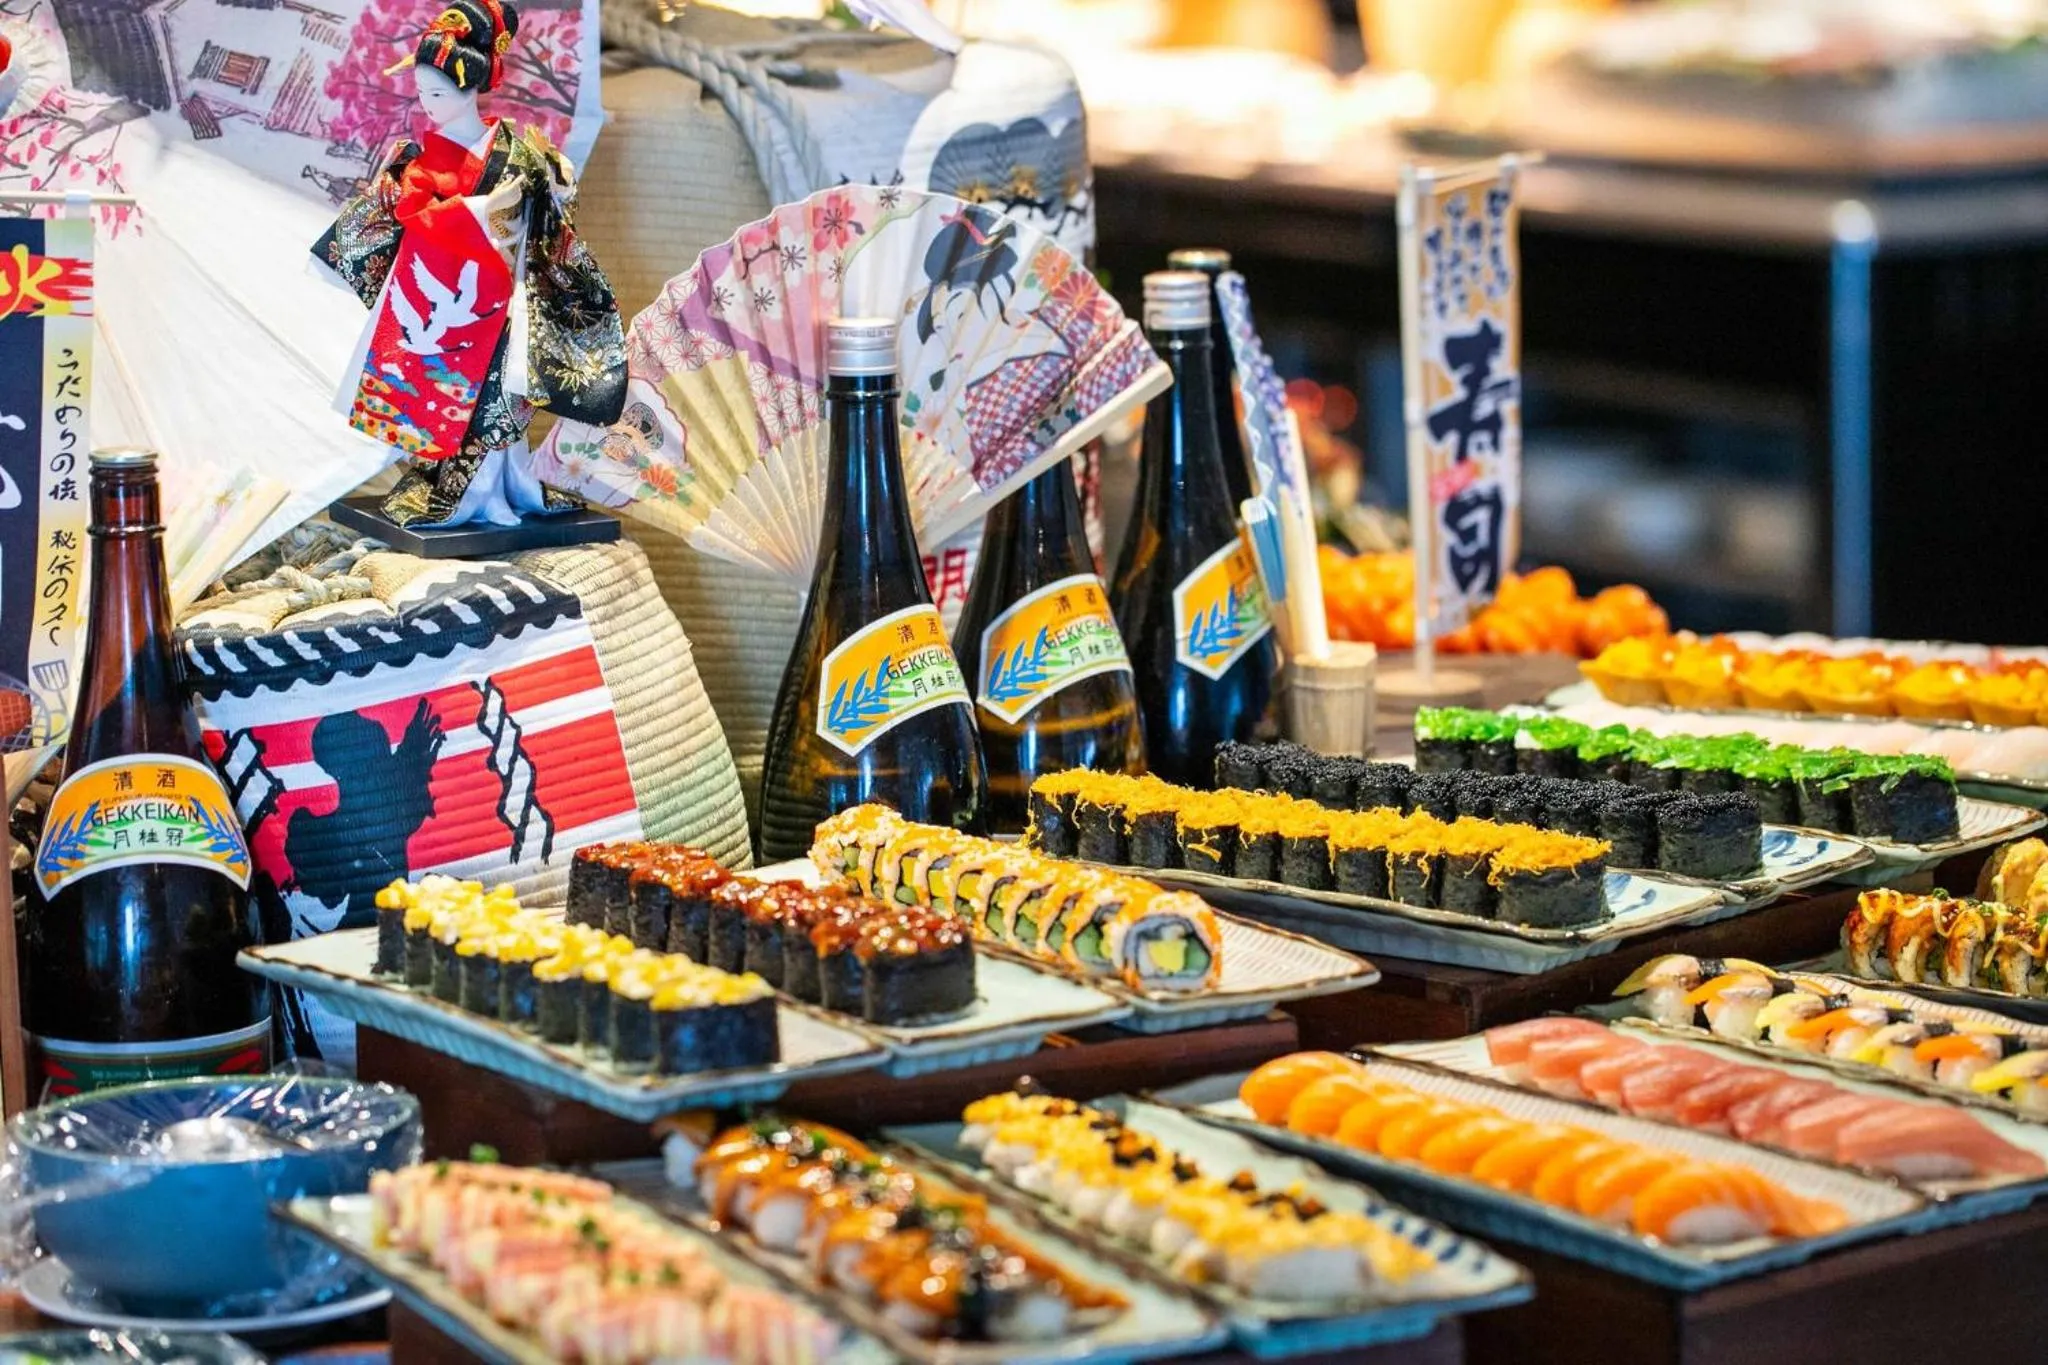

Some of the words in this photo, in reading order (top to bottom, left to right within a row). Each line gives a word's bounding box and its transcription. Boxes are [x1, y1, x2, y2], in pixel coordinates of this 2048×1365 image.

[887, 648, 953, 679] GEKKEIK
[112, 768, 177, 792] 清酒
[91, 802, 200, 828] GEKKEIKAN
[112, 827, 184, 850] 月桂冠
